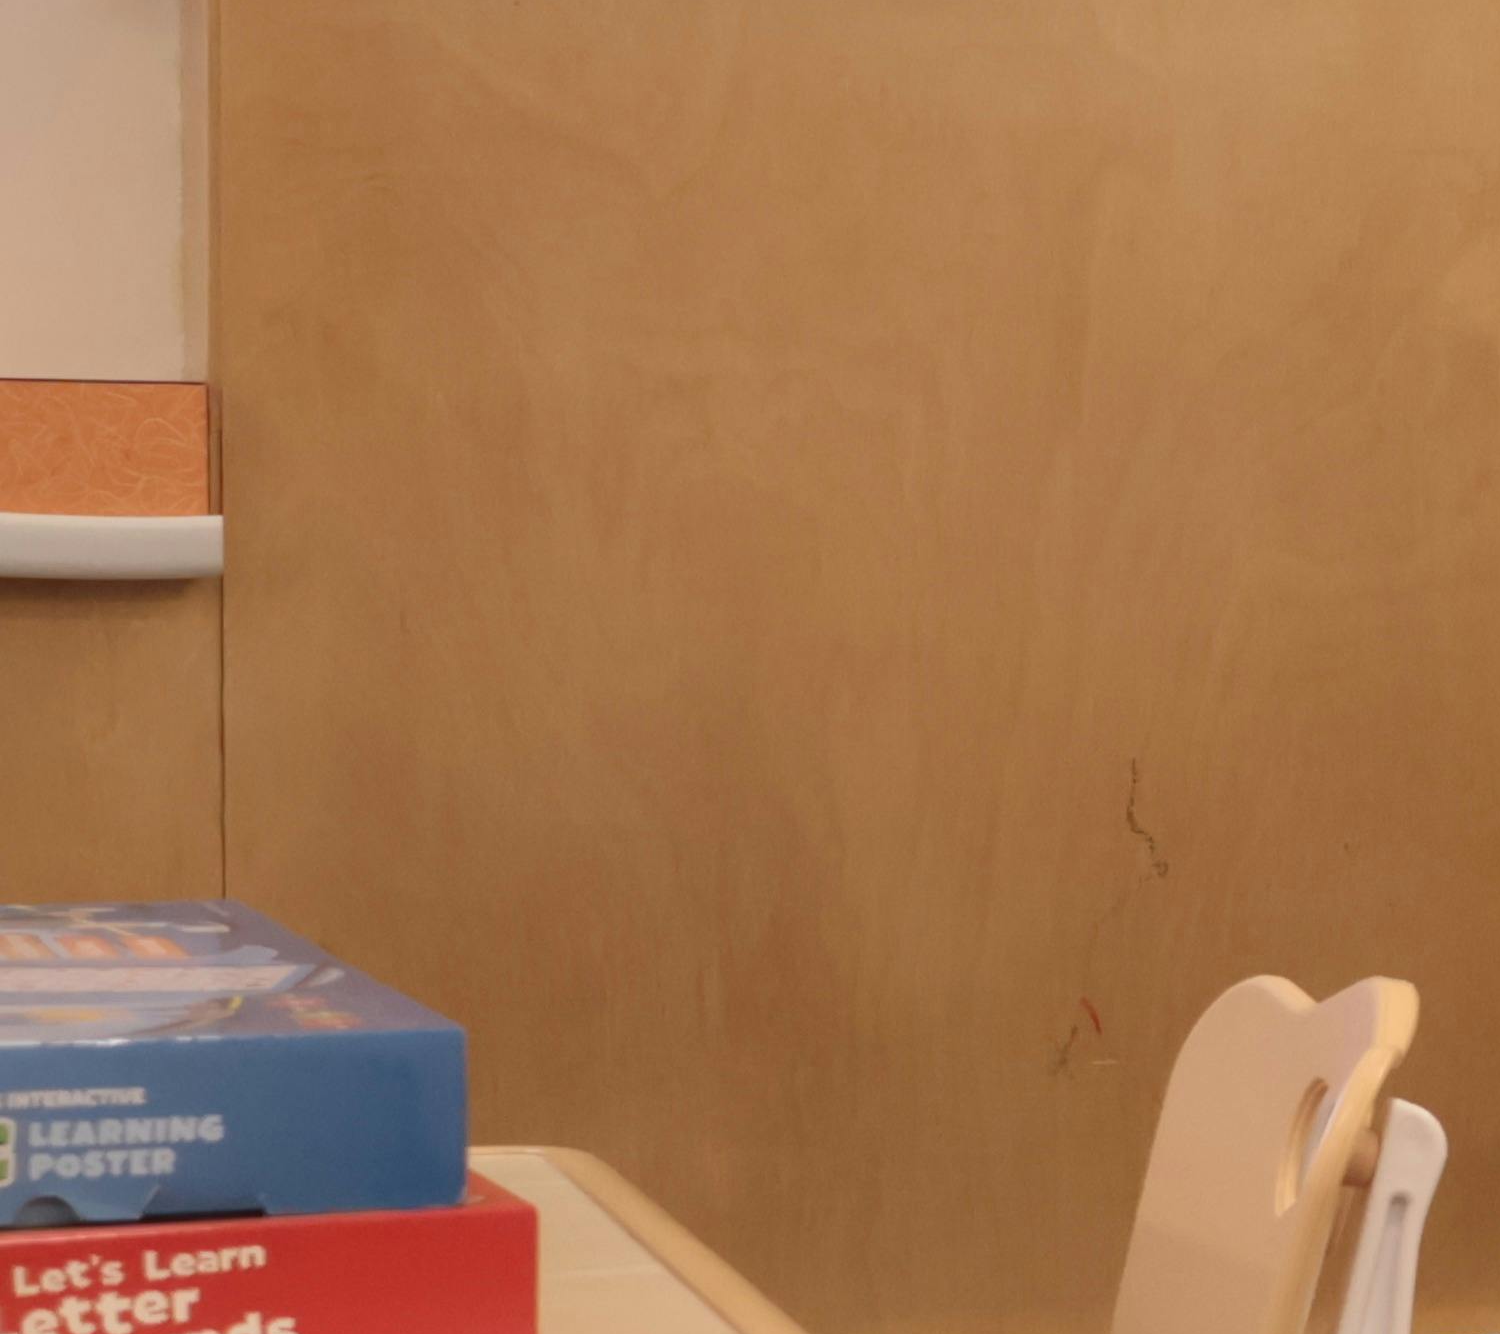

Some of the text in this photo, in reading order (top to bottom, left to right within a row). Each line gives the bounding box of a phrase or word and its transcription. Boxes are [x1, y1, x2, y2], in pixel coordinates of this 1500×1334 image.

[28, 1114, 225, 1147] LEARNING
[28, 1148, 177, 1180] POSTER
[12, 1244, 267, 1297] Let's Learn
